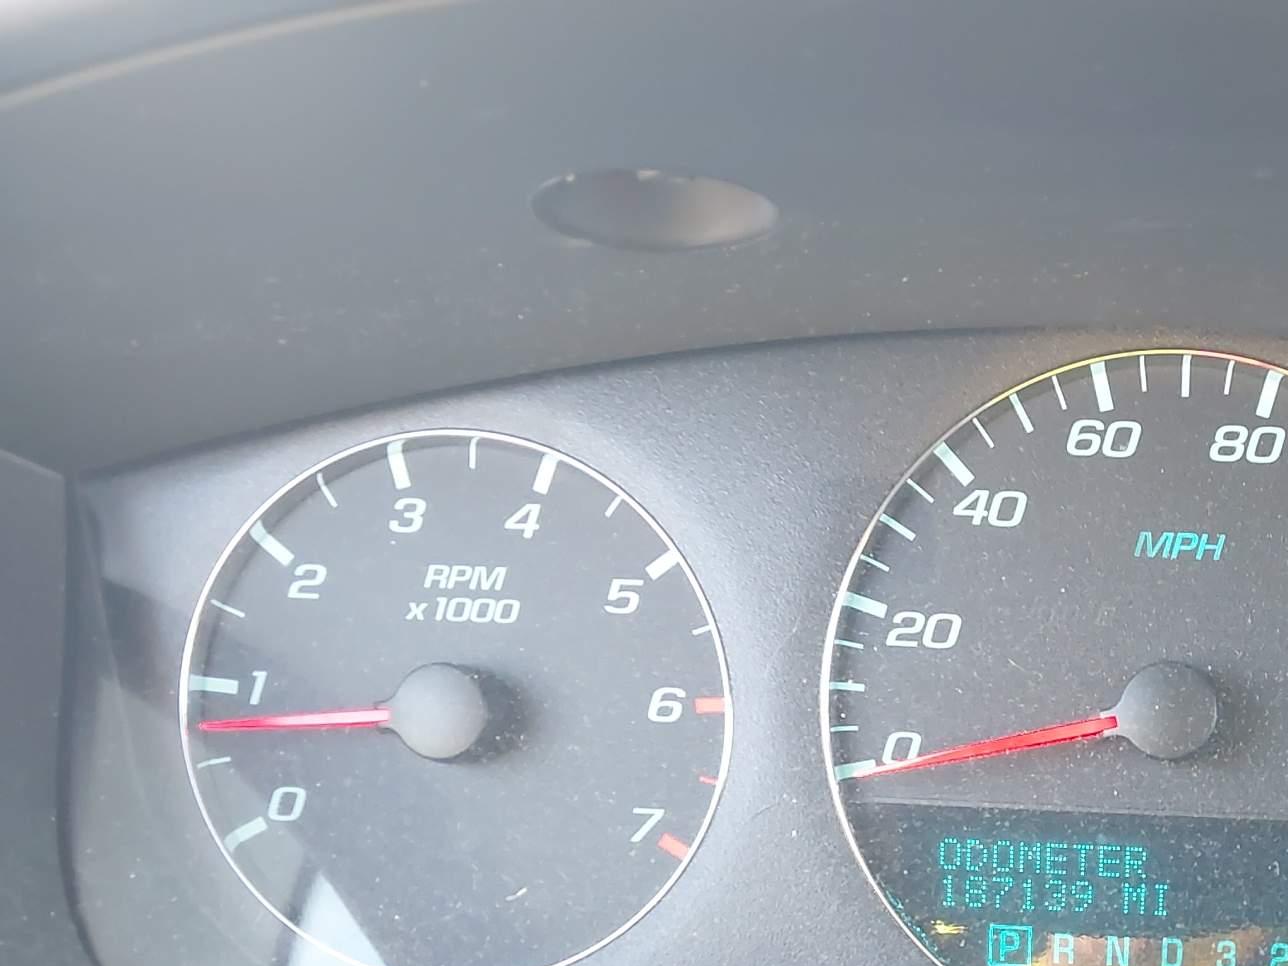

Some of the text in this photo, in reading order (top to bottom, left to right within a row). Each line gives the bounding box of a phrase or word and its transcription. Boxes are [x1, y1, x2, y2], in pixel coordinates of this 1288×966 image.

[1067, 420, 1142, 458] 60
[1209, 426, 1286, 464] 80
[389, 498, 427, 533] 3
[504, 503, 541, 538] 4
[953, 491, 1027, 527] 40
[1134, 531, 1225, 561] MPH
[287, 564, 327, 599] 2
[424, 564, 507, 590] RPM
[405, 597, 520, 623] x1000
[604, 578, 644, 614] 5
[886, 611, 961, 649] 20
[249, 671, 267, 704] 1
[647, 687, 686, 723] 6
[882, 731, 922, 766] 0
[267, 787, 306, 821] 0
[630, 807, 665, 843] 7
[939, 838, 1149, 878] ODOMETER
[940, 875, 1169, 916] 187139 MI
[1052, 934, 1075, 965] R
[1106, 936, 1129, 966] N
